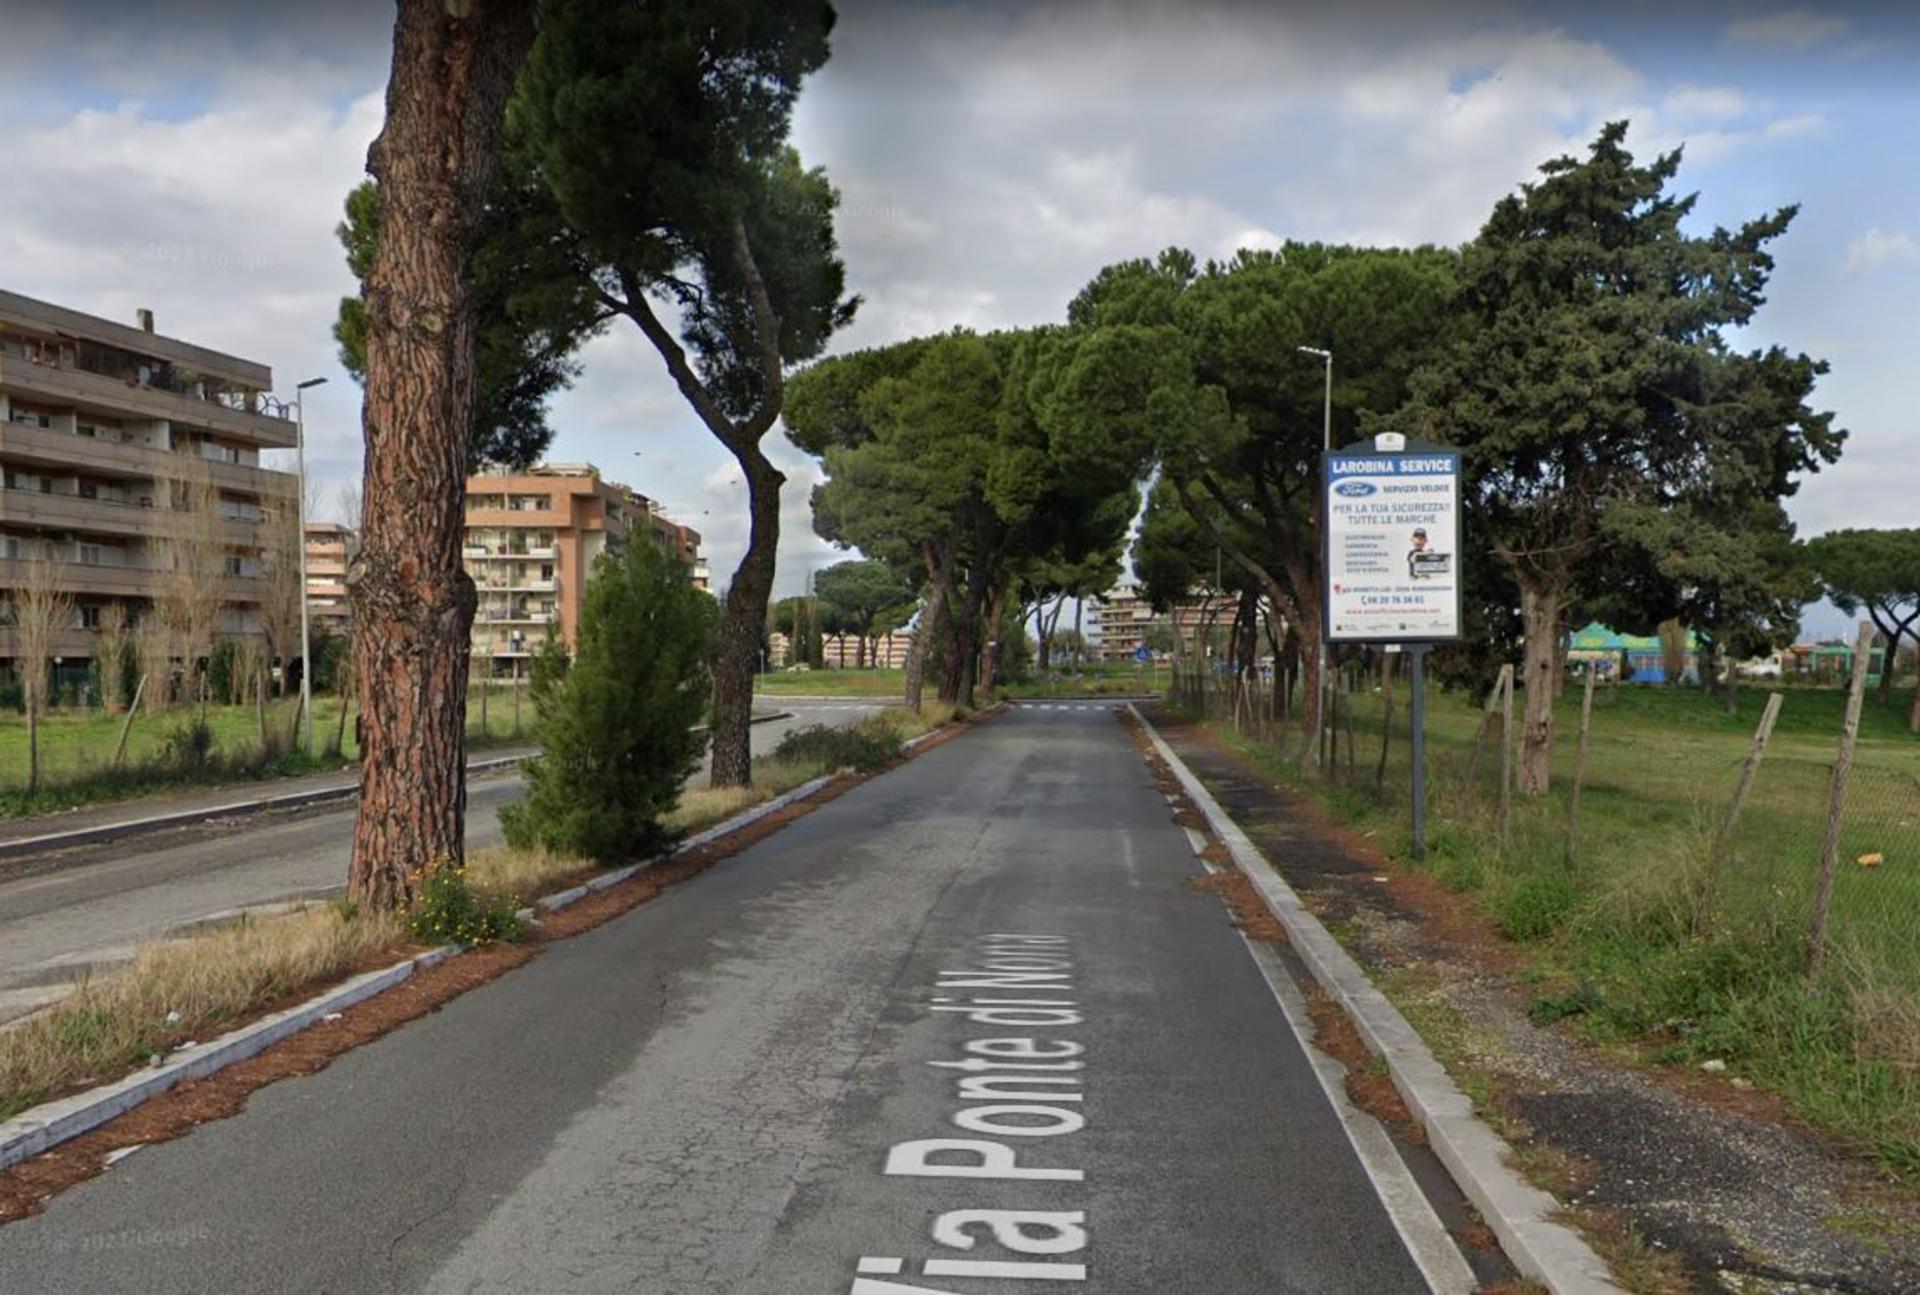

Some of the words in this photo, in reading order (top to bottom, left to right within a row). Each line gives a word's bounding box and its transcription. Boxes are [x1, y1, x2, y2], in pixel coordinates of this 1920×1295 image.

[1332, 460, 1394, 473] LAROBINA
[1401, 459, 1452, 472] SERVICE
[1420, 484, 1450, 493] VELOCE
[1333, 504, 1353, 514] PER
[1355, 504, 1367, 513] LA
[1370, 503, 1389, 513] TUA
[1348, 515, 1377, 525] TUTTE
[1381, 515, 1392, 524] LE
[1396, 514, 1436, 524] MARCHE
[928, 997, 1084, 1026] di
[884, 1037, 1086, 1181] Ponte
[850, 1208, 1087, 1295] ia
